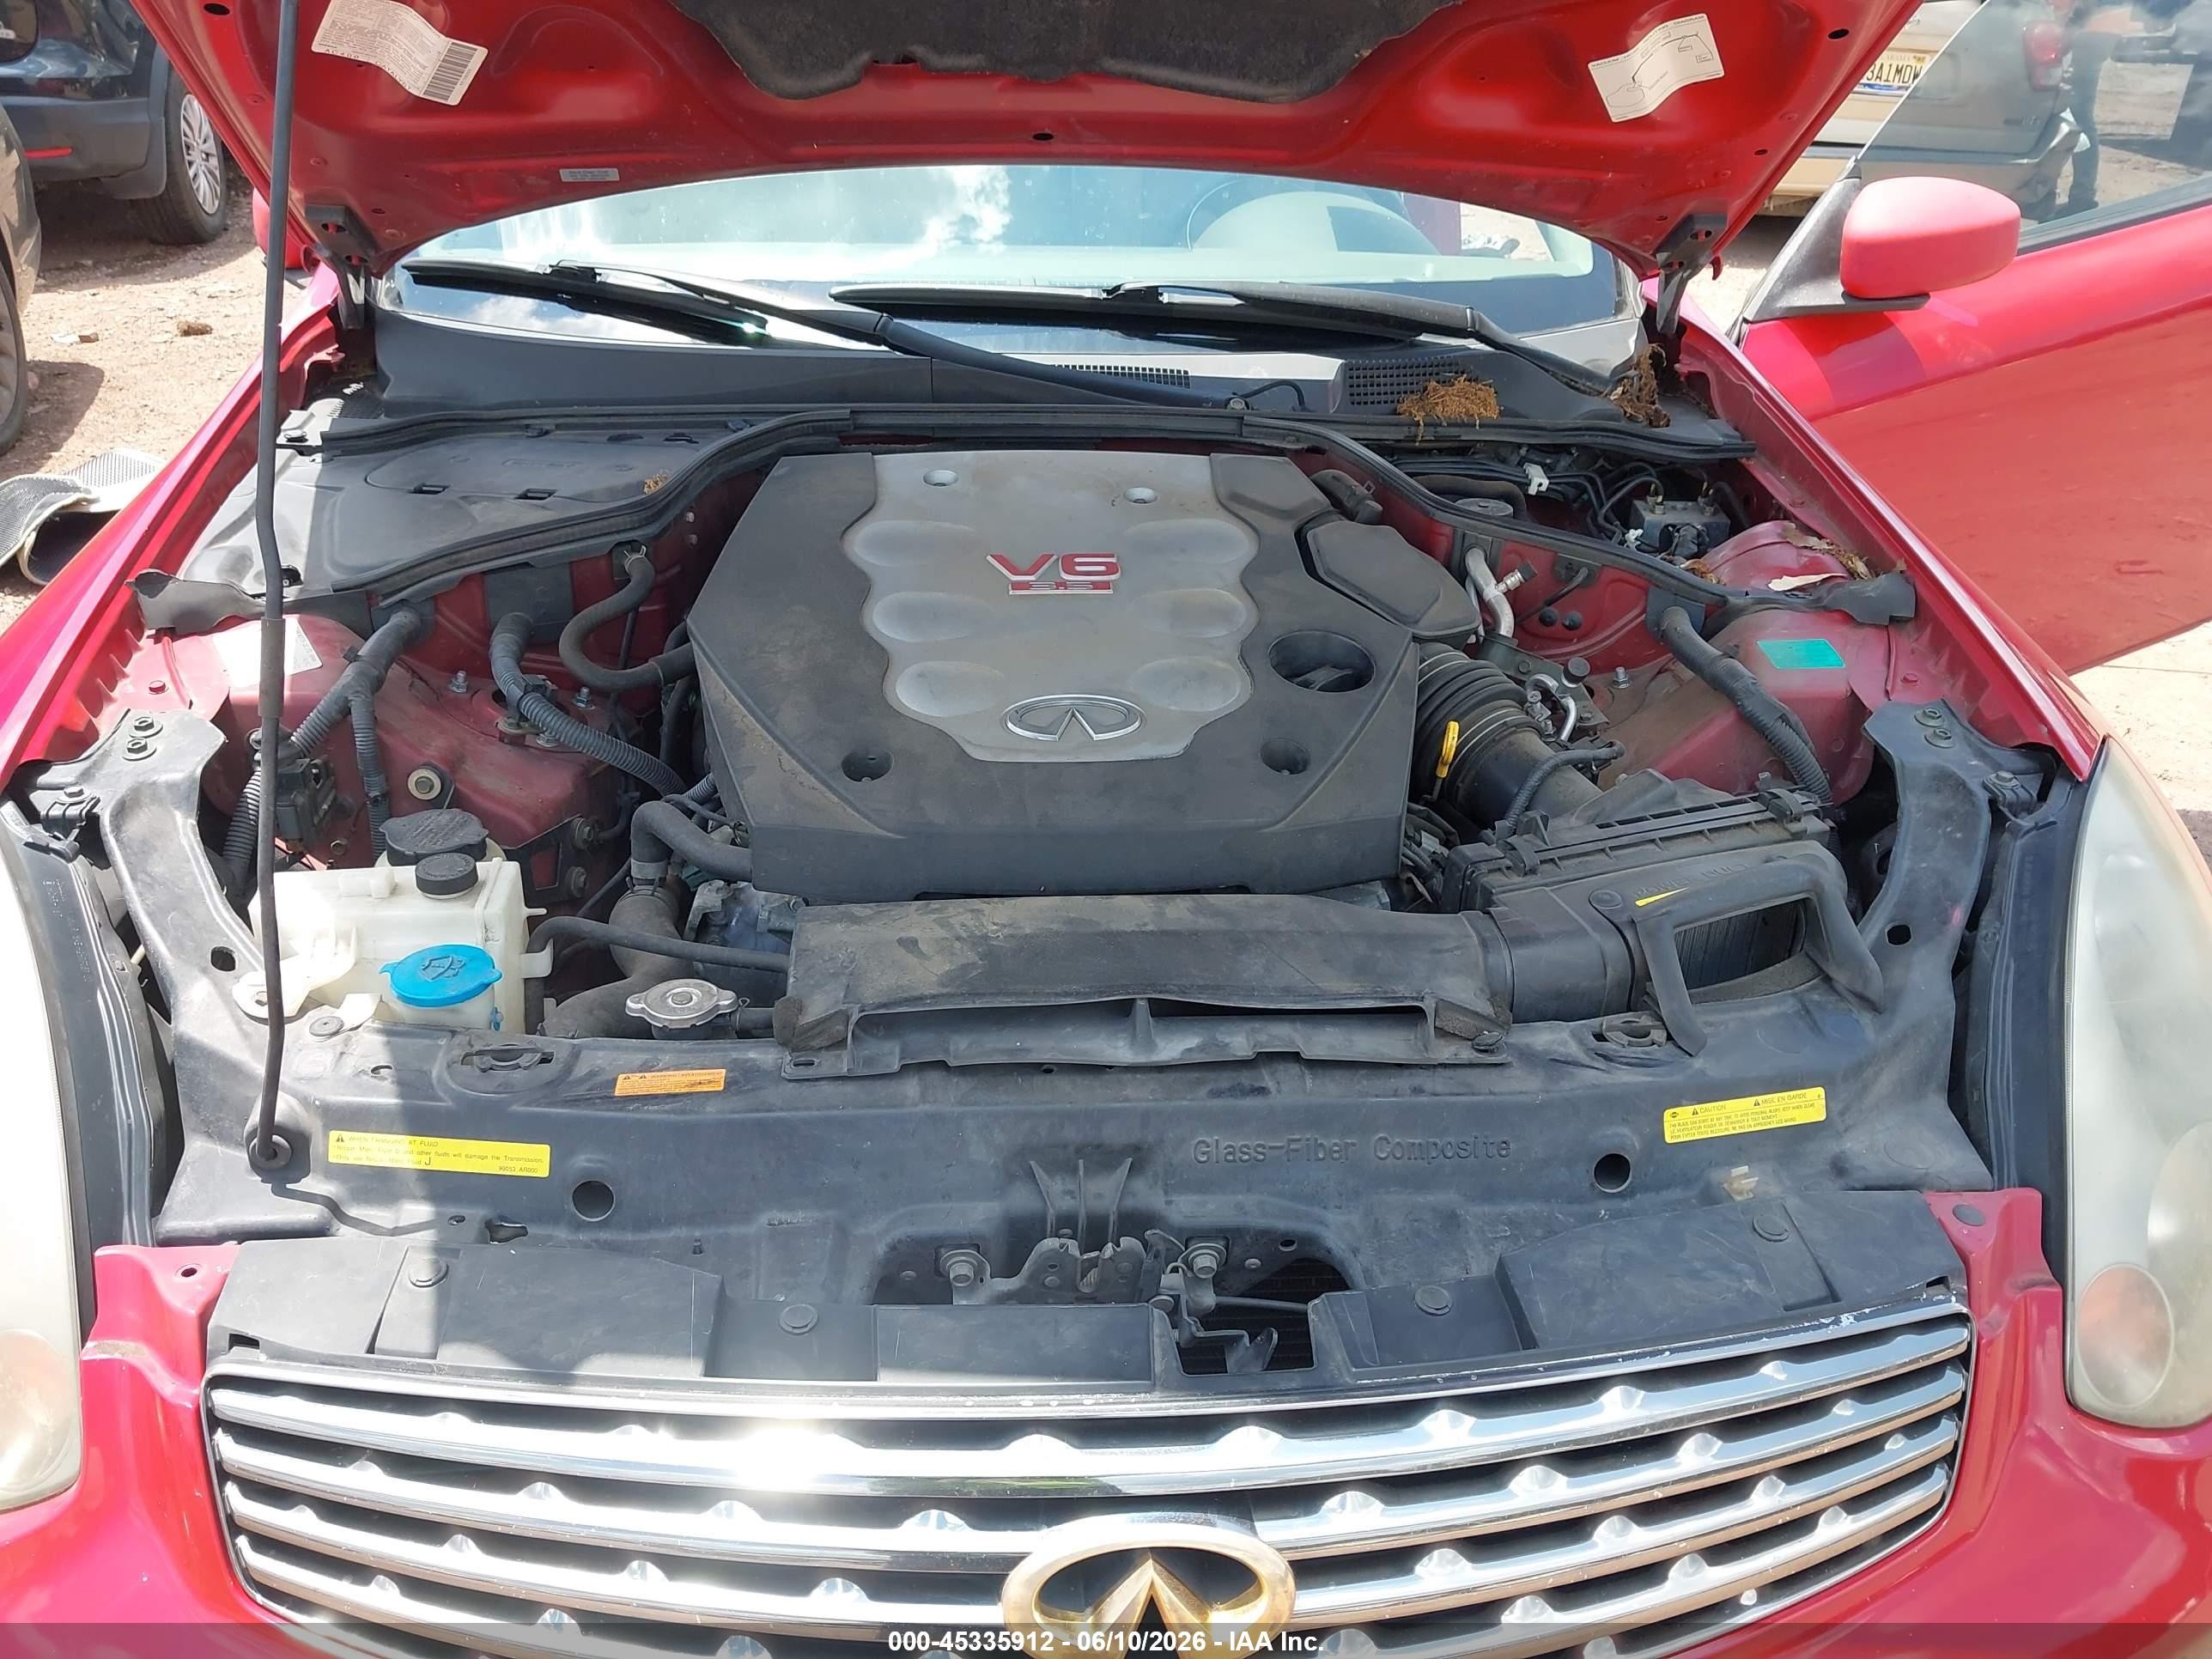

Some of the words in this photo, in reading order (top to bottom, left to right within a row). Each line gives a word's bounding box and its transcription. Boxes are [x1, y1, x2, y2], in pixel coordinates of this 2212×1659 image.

[986, 552, 1121, 581] V6
[1699, 1103, 1726, 1114] CAUTION
[1193, 1134, 1357, 1164] Glass-Fiber
[1373, 1133, 1512, 1164] Composite
